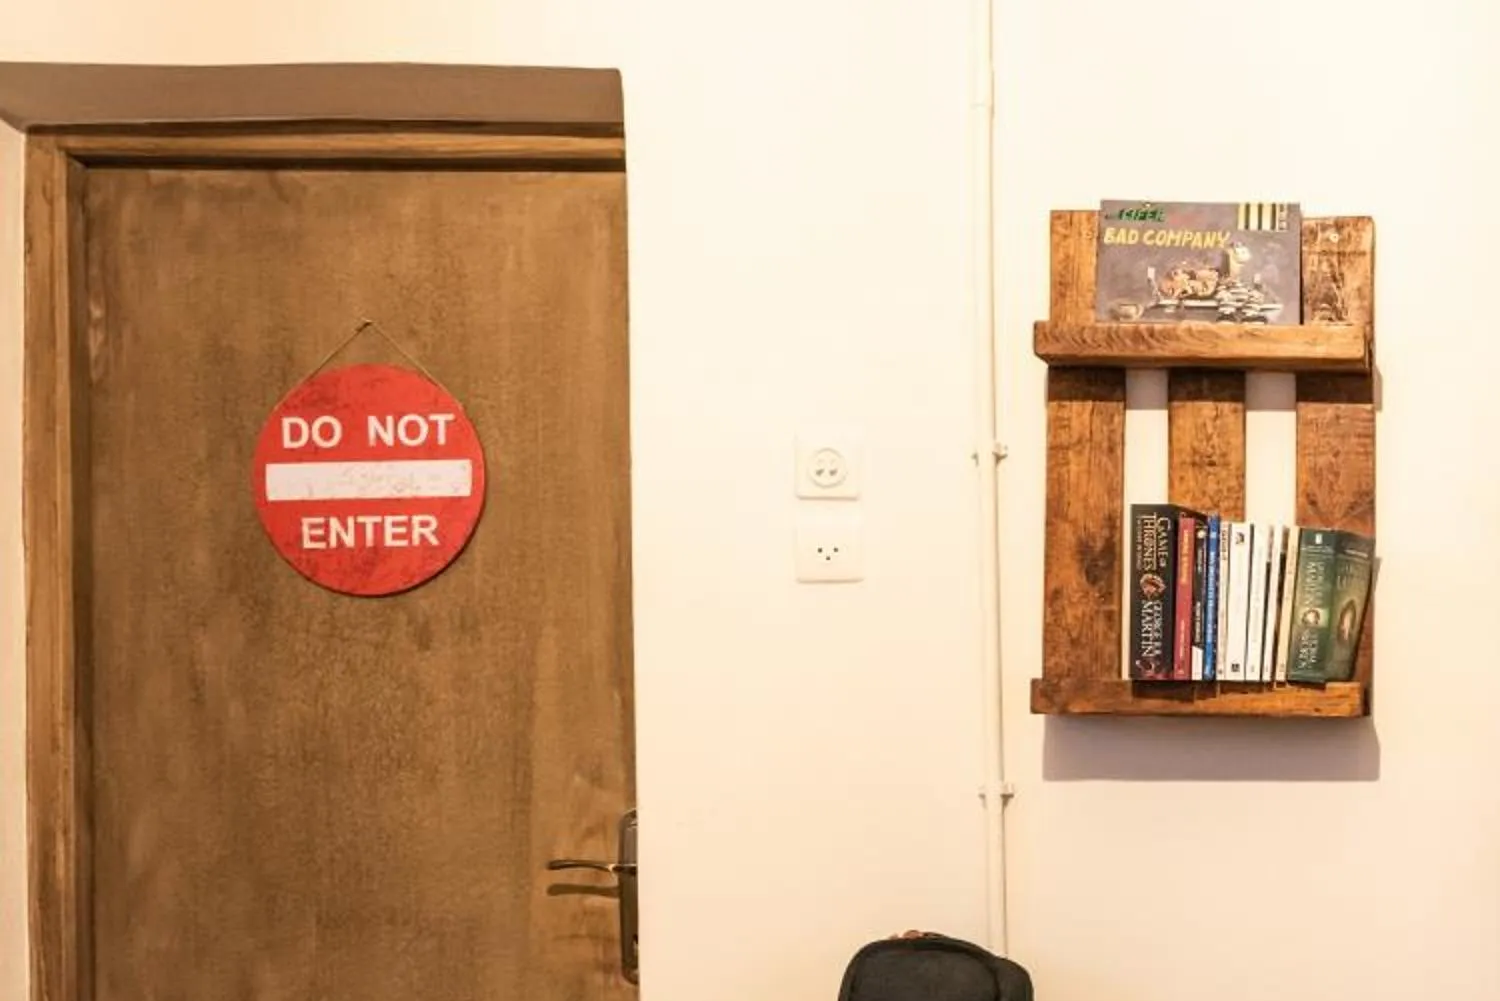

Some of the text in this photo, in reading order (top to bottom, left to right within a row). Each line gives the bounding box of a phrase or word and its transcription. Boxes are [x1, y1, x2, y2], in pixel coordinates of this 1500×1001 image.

[1103, 227, 1231, 249] BAD COMPANY
[281, 413, 455, 449] DO NOT
[301, 514, 441, 550] ENTER
[1136, 511, 1157, 572] THRONES
[1157, 516, 1171, 557] GAME
[1141, 600, 1155, 657] MARTIN
